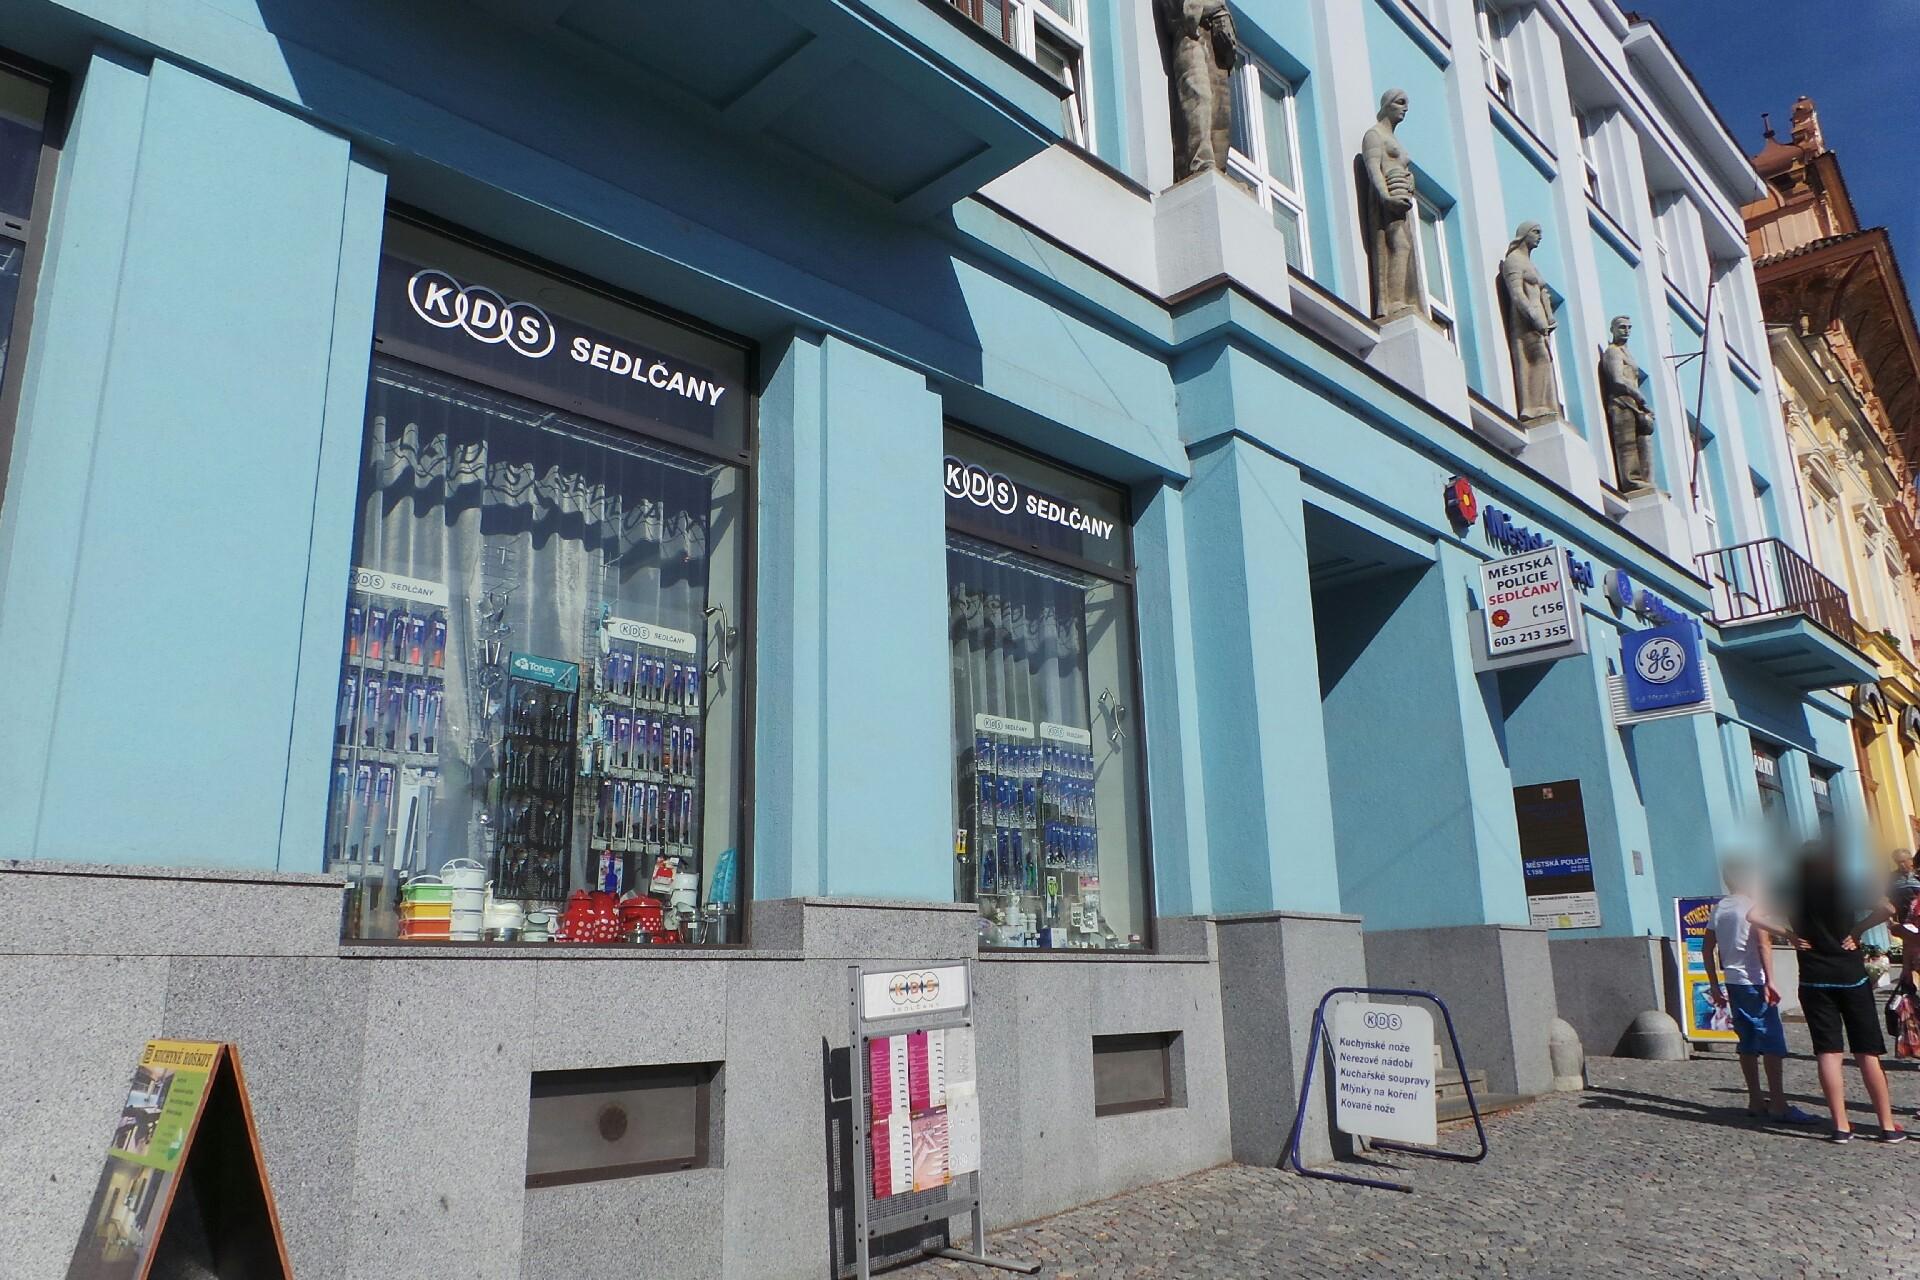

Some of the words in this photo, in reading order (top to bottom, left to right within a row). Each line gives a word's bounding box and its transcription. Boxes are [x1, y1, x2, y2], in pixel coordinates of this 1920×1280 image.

[419, 278, 546, 351] KDS
[570, 337, 725, 406] SEDLČANY
[944, 461, 1012, 508] KDS
[1025, 494, 1114, 540] SEDLČANY
[1488, 555, 1553, 580] MĚSTSKÁ
[390, 582, 434, 597] SEDLČANY
[1496, 570, 1549, 591] POLICIE
[1488, 581, 1559, 605] SEDLČANY
[1540, 601, 1564, 615] 156
[1494, 634, 1516, 648] 603
[1520, 630, 1541, 643] 213
[1544, 624, 1567, 638] 355
[1560, 857, 1590, 866] POLICIE
[1365, 1014, 1400, 1029] KDS
[1388, 1040, 1411, 1053] nože
[1339, 1052, 1379, 1065] Nerezové
[1381, 1056, 1413, 1069] nádobí
[1340, 1067, 1386, 1081] Kuchařské
[1388, 1074, 1431, 1089] soupravy
[1340, 1083, 1372, 1097] Mlýnky
[1373, 1088, 1385, 1097] na
[1387, 1088, 1418, 1101] koření
[1340, 1098, 1372, 1111] Kované
[1374, 1102, 1396, 1114] nože
